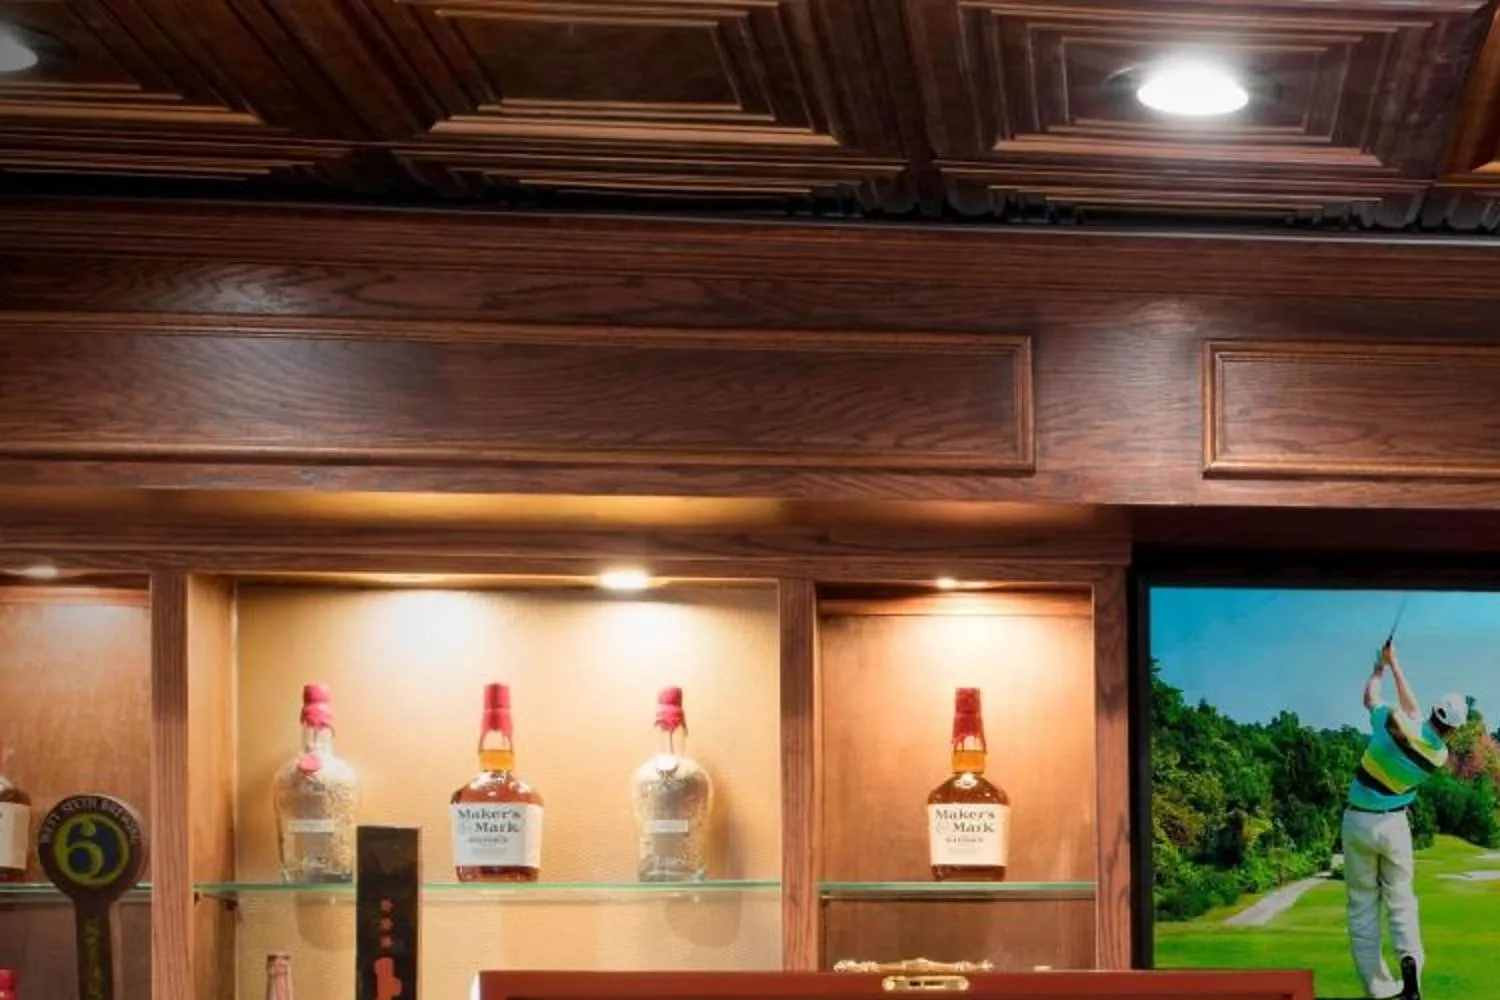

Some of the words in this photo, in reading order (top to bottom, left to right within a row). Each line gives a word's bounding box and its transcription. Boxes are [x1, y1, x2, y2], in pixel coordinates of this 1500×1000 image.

[457, 807, 521, 820] Maker's
[935, 808, 996, 820] Maker's
[474, 820, 520, 833] Mark
[952, 821, 995, 833] Mark
